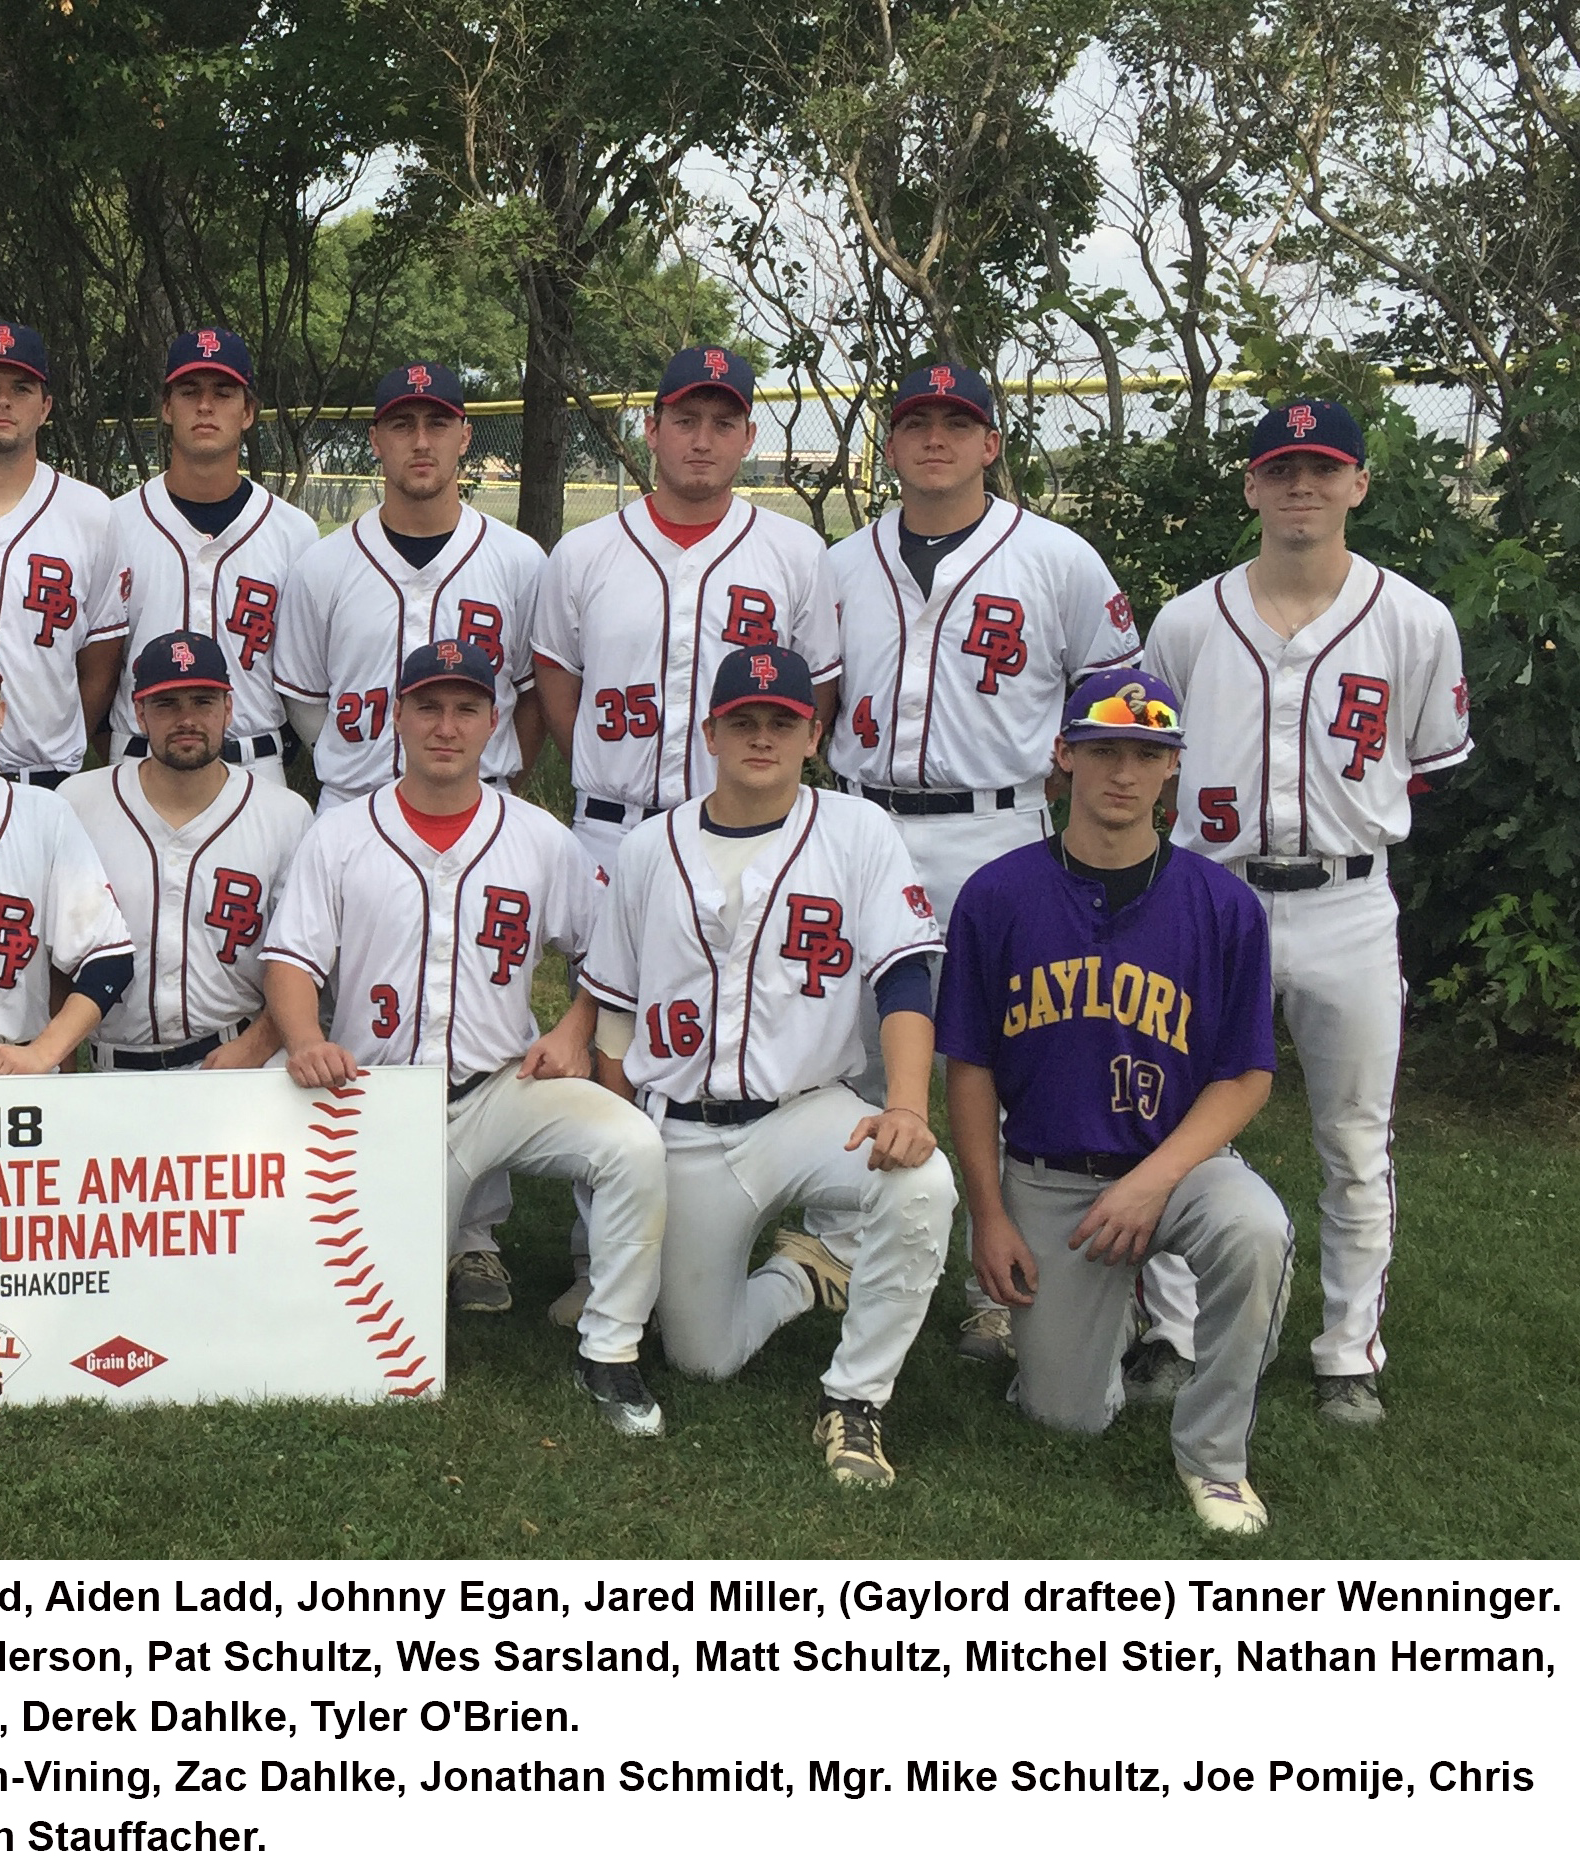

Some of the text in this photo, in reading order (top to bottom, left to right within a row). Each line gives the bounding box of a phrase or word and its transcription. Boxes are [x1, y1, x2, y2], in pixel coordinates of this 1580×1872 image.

[23, 553, 77, 648] BP
[226, 576, 276, 672] BP
[722, 585, 778, 648] B
[961, 593, 1028, 695] BP
[336, 687, 388, 743] 27
[595, 684, 659, 741] 35
[852, 696, 880, 749] 4
[1328, 673, 1391, 782] BP
[1198, 787, 1241, 843] 5
[205, 867, 264, 965] BP
[476, 885, 531, 986] BP
[780, 893, 854, 999] BP
[370, 984, 400, 1039] 3
[646, 999, 705, 1058] 16
[1110, 1055, 1165, 1120] 19
[78, 1152, 286, 1204] AMATEUR
[0, 1270, 110, 1298] SHAKOPEE
[86, 1351, 154, 1372] Grain Belt
